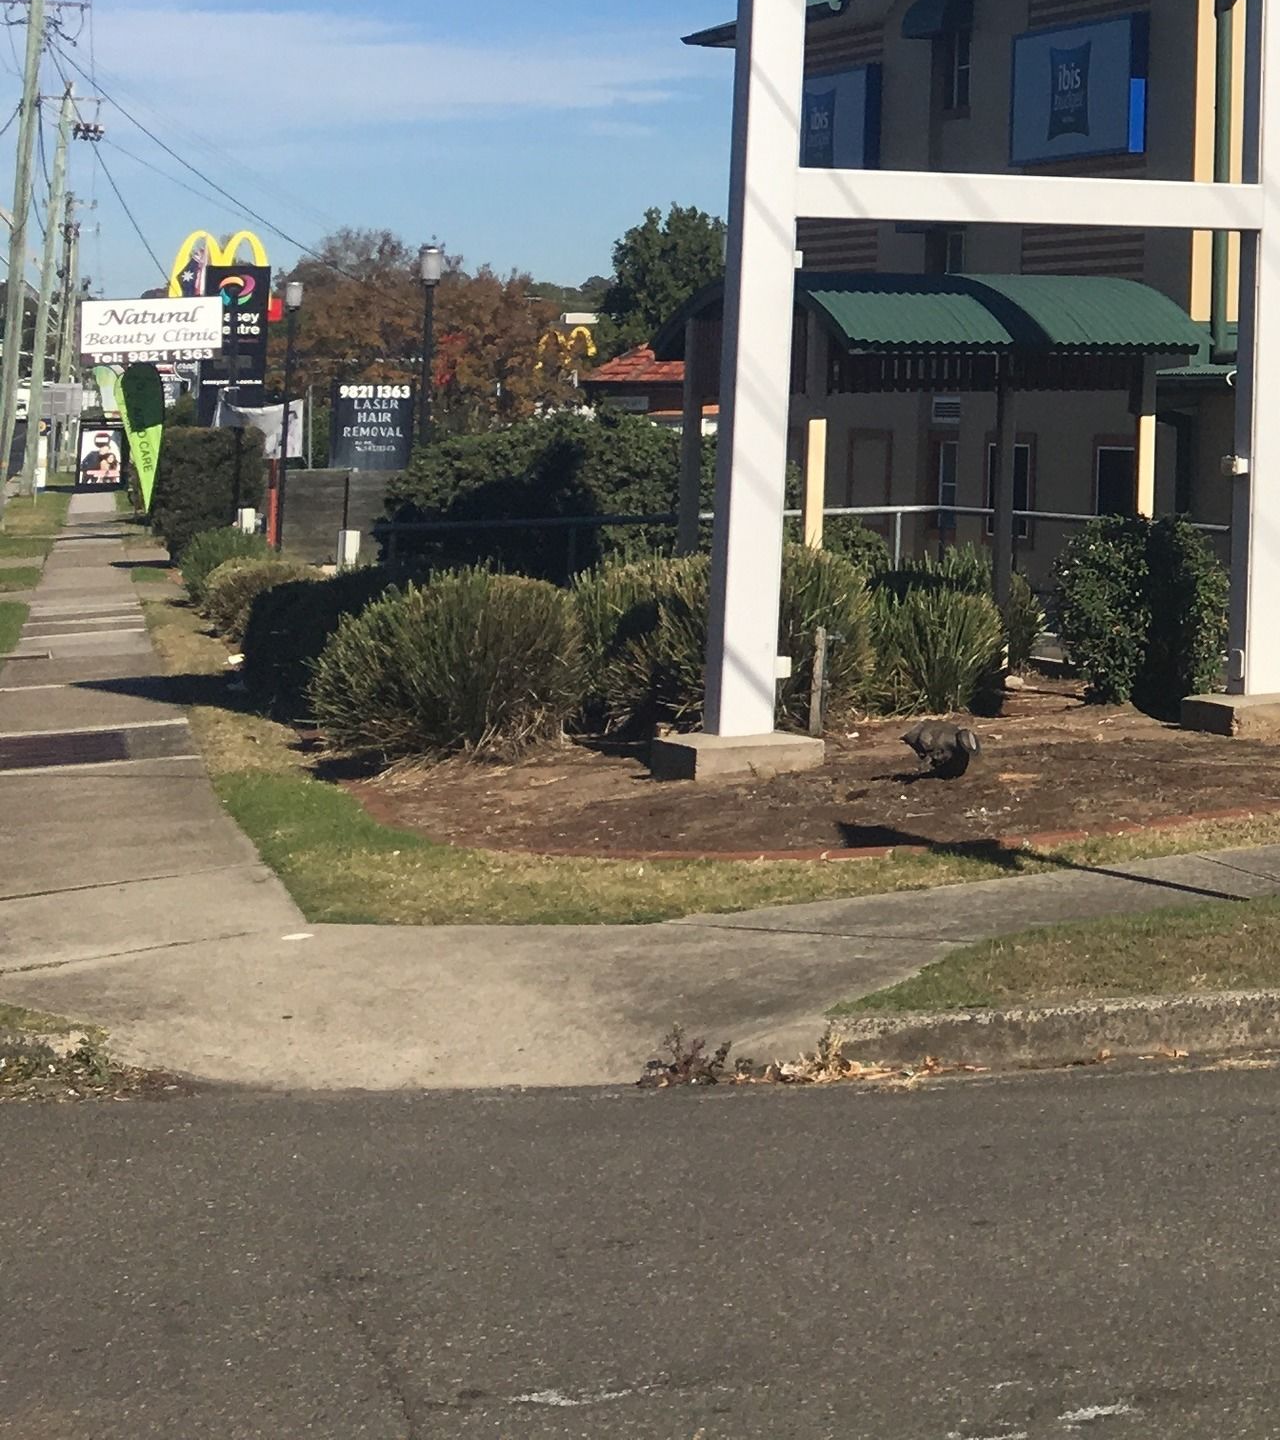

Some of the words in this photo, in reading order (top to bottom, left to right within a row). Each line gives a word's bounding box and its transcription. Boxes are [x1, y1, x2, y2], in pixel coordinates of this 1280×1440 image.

[1058, 62, 1081, 91] ibis
[97, 306, 204, 326] Natural
[84, 332, 156, 346] Beauty
[163, 327, 218, 343] Clinic
[91, 352, 123, 364] Tel:
[126, 350, 168, 362] 9821
[171, 348, 213, 361] 1363
[339, 385, 374, 399] 9821
[376, 385, 411, 399] 1363
[353, 398, 399, 410] LASER
[357, 411, 392, 423] HAIR
[342, 426, 404, 438] REMOVAL
[138, 440, 154, 473] CARE
